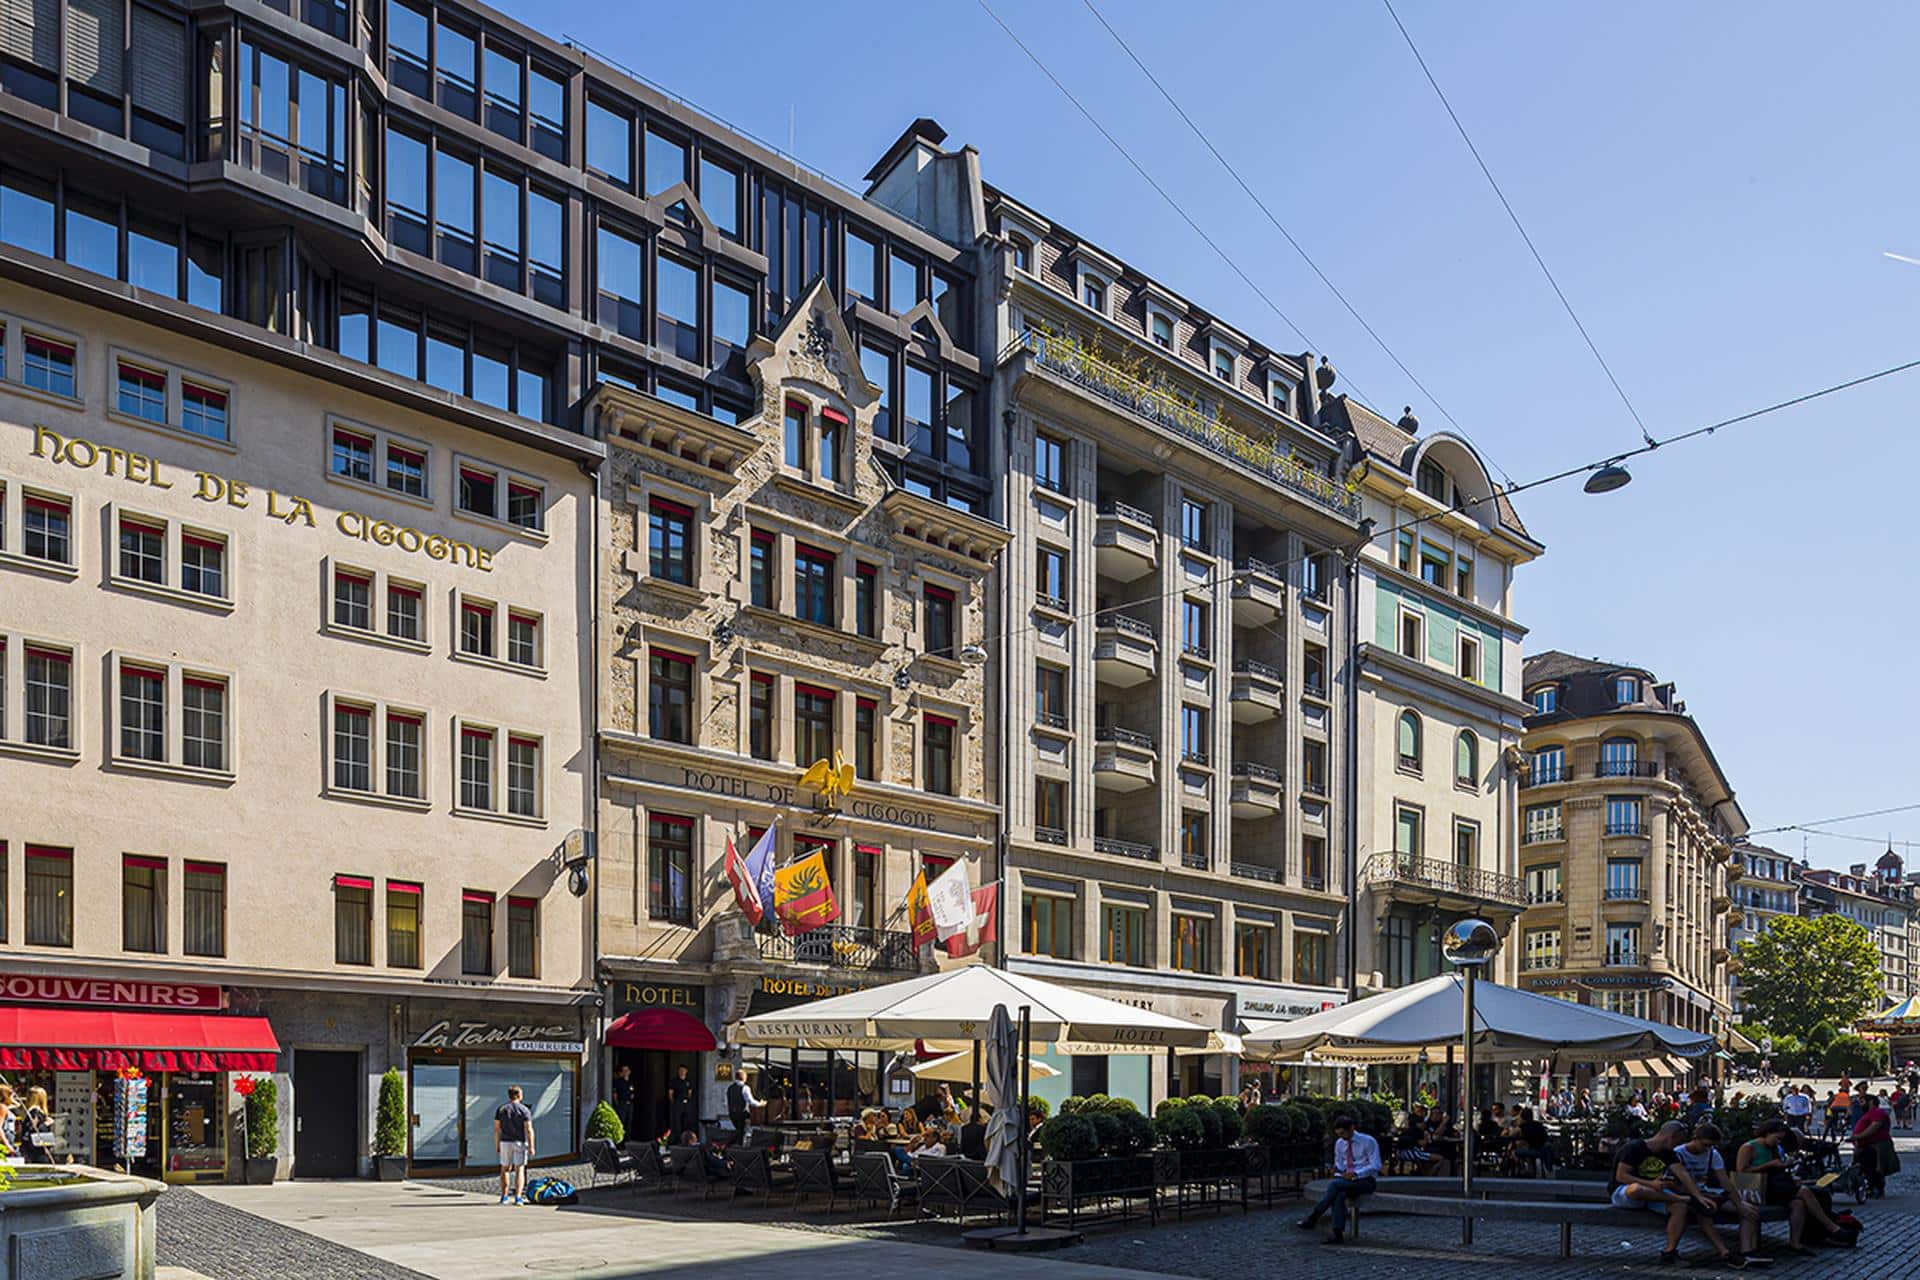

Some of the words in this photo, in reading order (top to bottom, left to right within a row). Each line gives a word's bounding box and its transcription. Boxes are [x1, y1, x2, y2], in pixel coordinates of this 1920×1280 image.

[30, 423, 174, 490] HOTEL
[193, 471, 250, 509] DE
[266, 489, 317, 528] LA
[336, 510, 494, 573] CIGOGNE
[683, 766, 756, 800] HOTEL
[766, 784, 795, 806] DE
[852, 799, 937, 831] CIGOGNE
[0, 975, 200, 1006] OUVENIRS
[625, 982, 697, 1006] HOTEL
[761, 976, 811, 997] HOTEL
[414, 1021, 451, 1047] La
[757, 1022, 853, 1036] RESTAURANT
